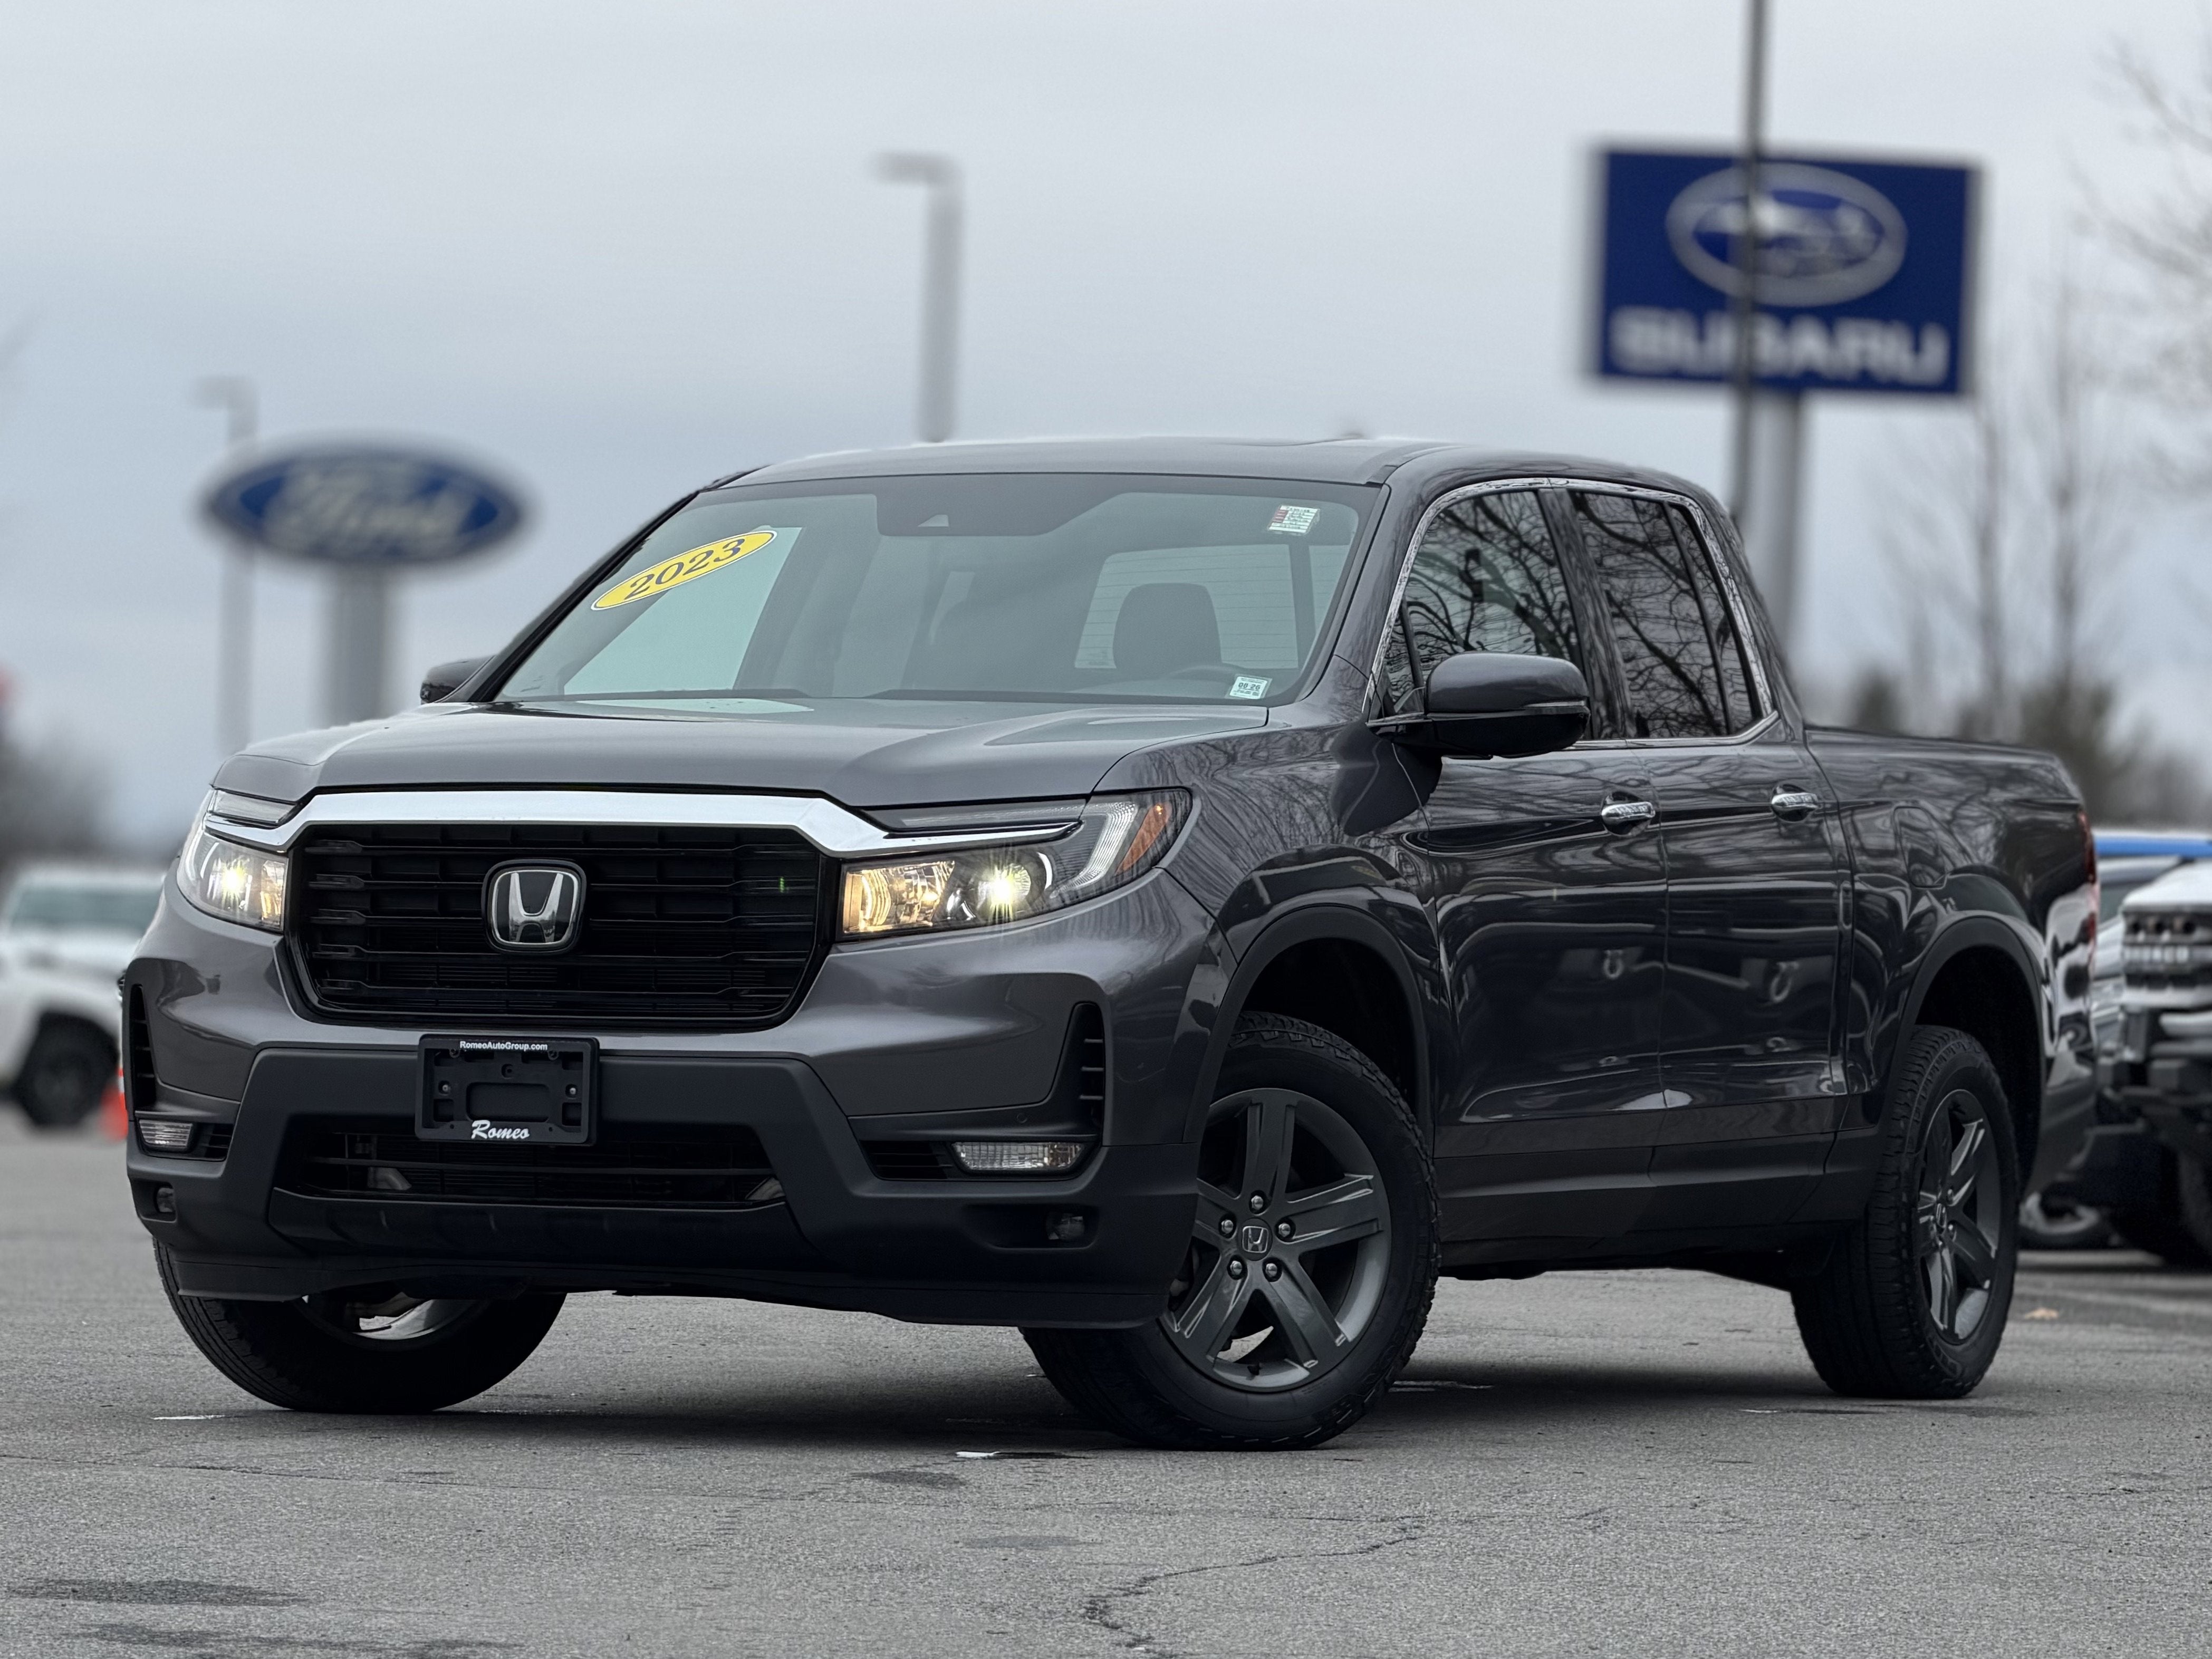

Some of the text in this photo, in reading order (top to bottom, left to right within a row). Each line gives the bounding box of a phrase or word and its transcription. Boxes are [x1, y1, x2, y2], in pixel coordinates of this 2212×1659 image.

[624, 538, 745, 601] 2023
[460, 1040, 548, 1052] RomeoAutoGroup.com
[471, 1120, 530, 1140] Romeo
